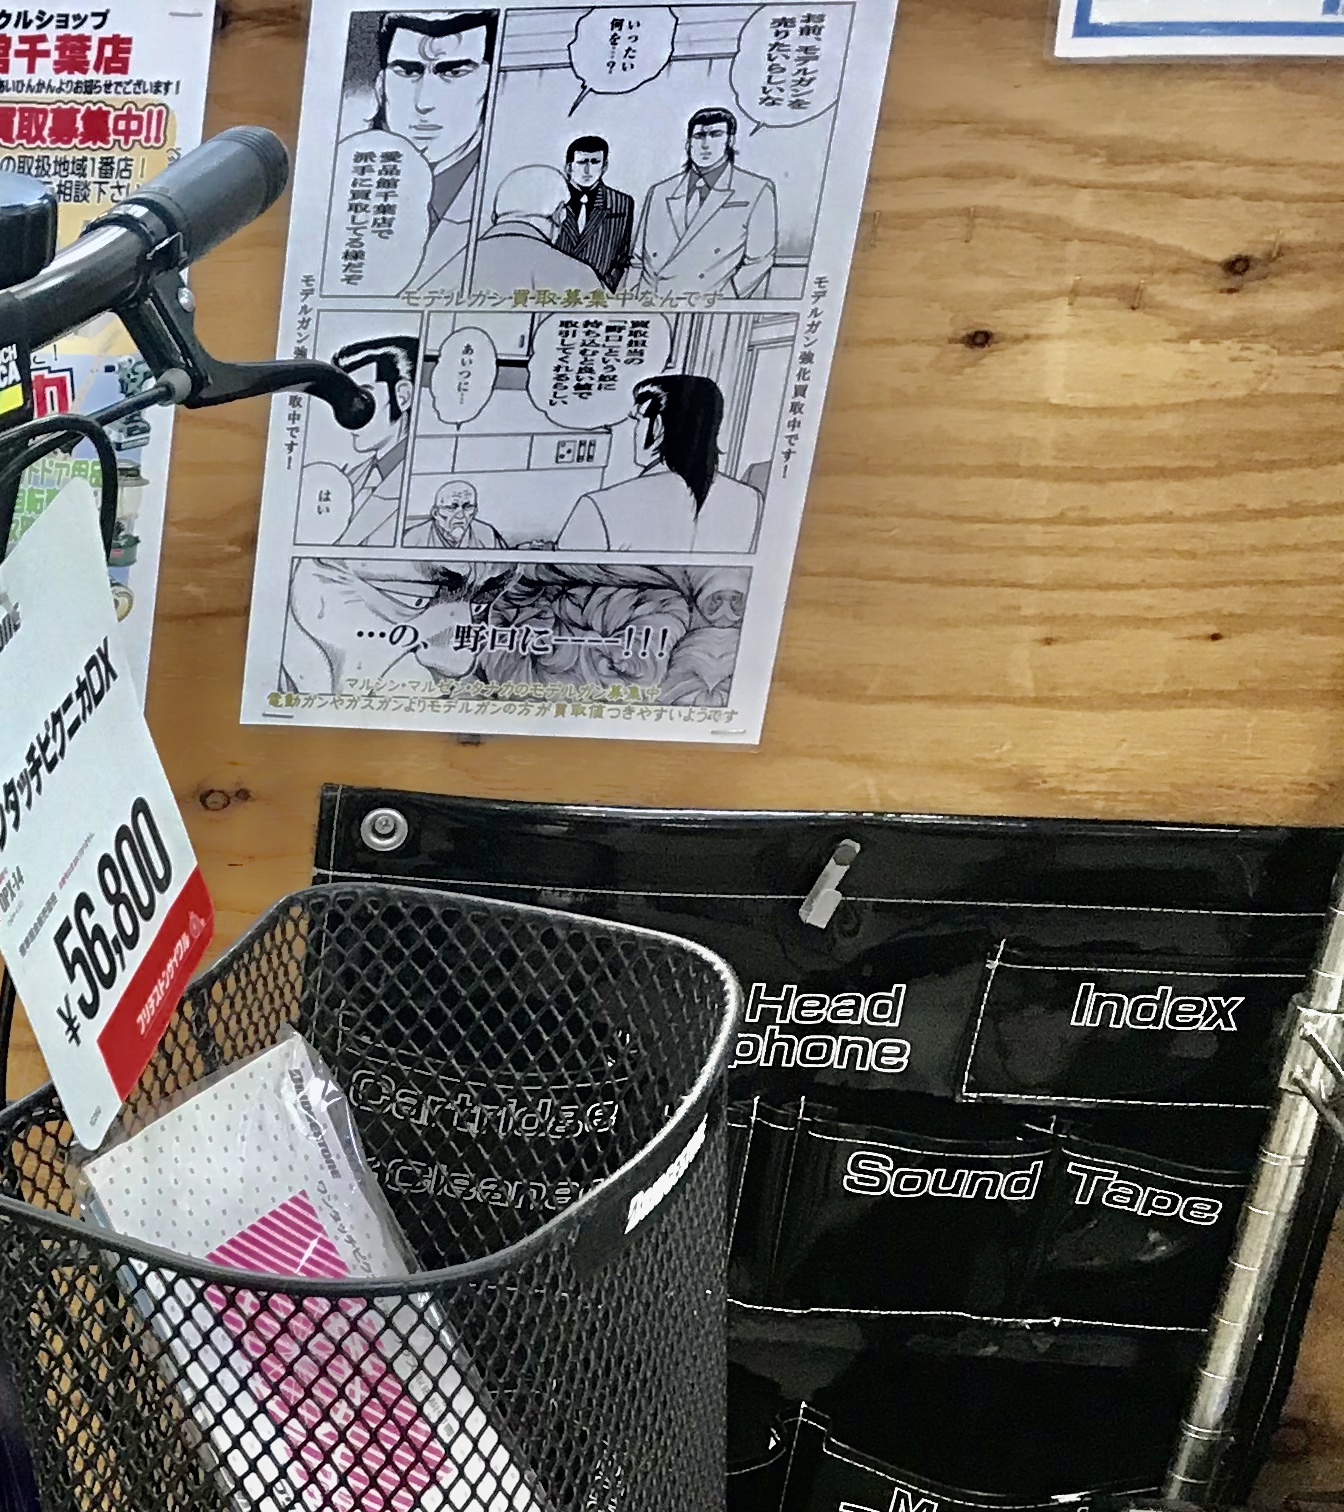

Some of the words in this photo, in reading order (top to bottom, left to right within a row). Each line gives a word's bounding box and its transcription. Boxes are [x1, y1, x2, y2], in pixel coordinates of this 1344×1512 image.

[620, 18, 643, 73] いったい
[758, 16, 801, 108] 売りたいらしいな
[369, 150, 404, 240] 愛品館千葉店で
[401, 285, 724, 310] モデルガン買取募集中なんです
[316, 488, 331, 515] はい
[745, 982, 907, 1028] Head
[1070, 982, 1246, 1032] Index
[843, 1150, 1044, 1201] Sound
[1067, 1162, 1224, 1227] Tape
